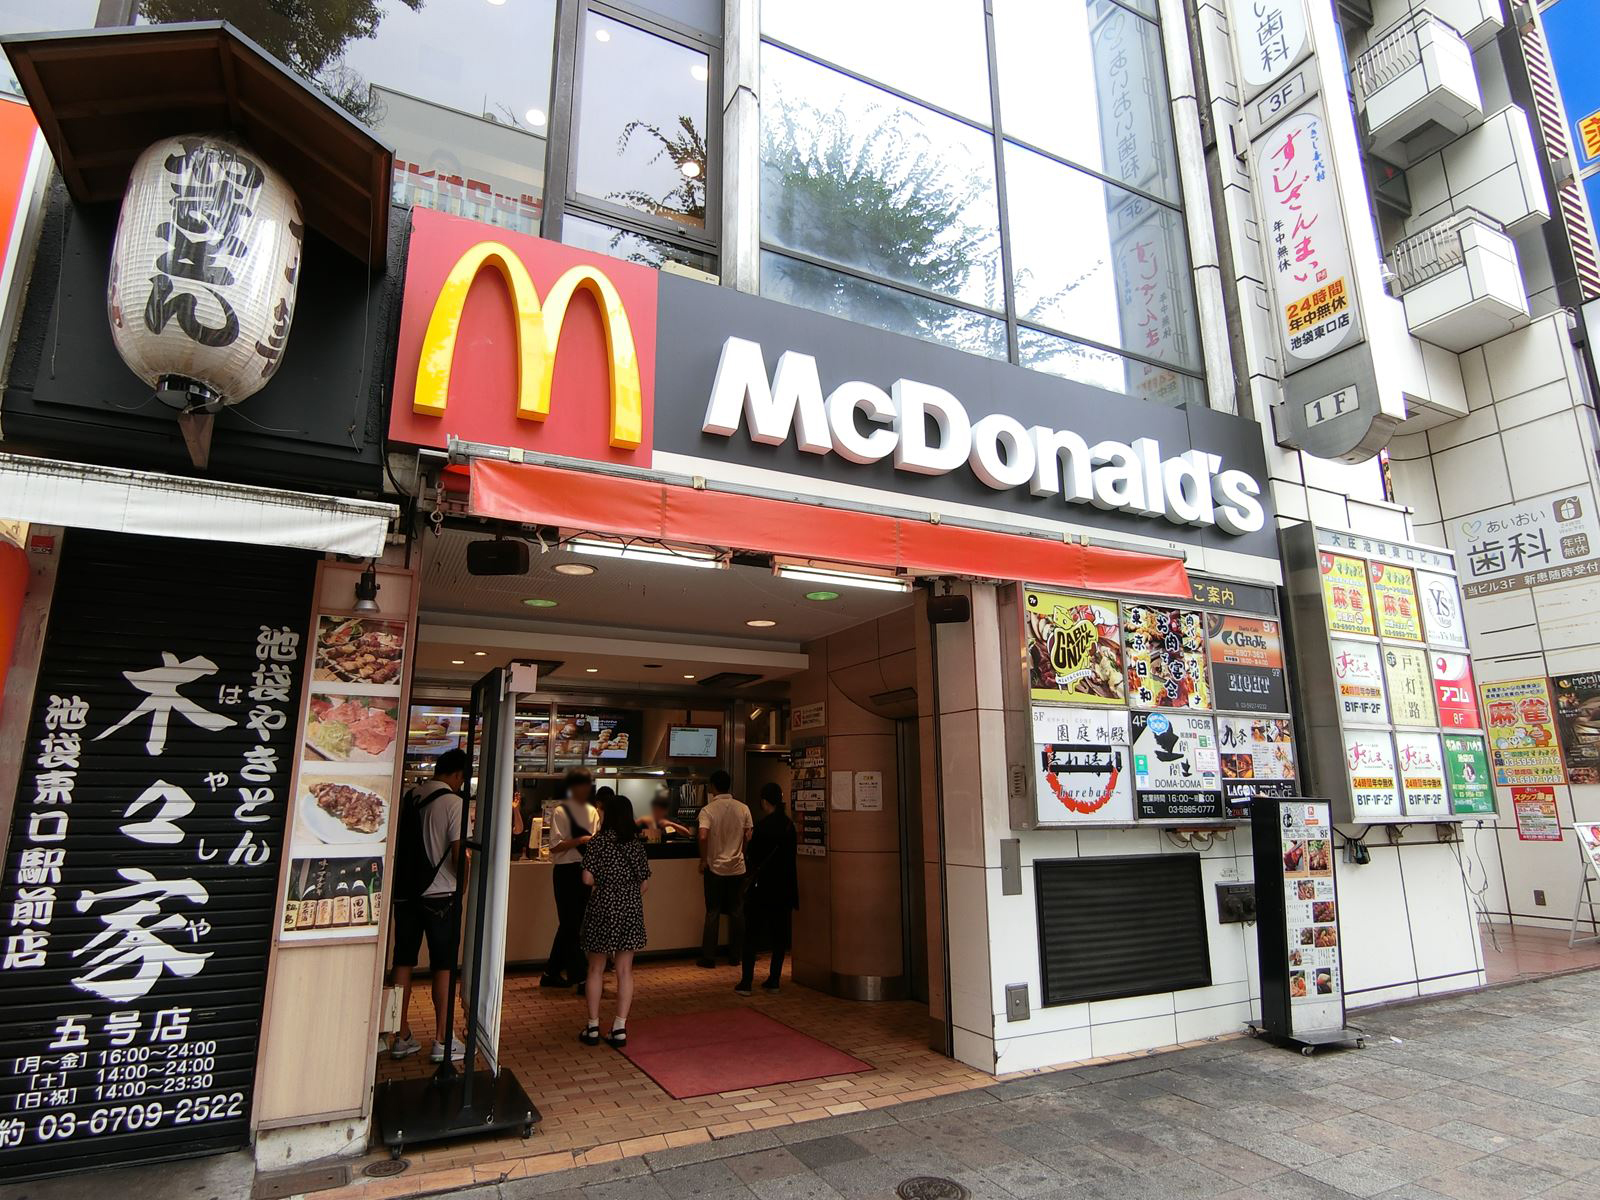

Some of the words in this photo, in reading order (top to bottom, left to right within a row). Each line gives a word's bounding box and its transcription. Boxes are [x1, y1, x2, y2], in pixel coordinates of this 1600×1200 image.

[1269, 83, 1294, 113] 3F
[1273, 219, 1292, 273] 年中無休
[1287, 279, 1345, 320] 24時間
[1289, 296, 1348, 332] 年中無休
[1291, 312, 1350, 352] 池袋東口店
[702, 334, 1267, 537] McDonald's
[1487, 510, 1545, 534] あいおい
[1467, 528, 1552, 577] 歯科
[1562, 536, 1585, 547] 年中
[1564, 545, 1589, 557] 無休
[1467, 579, 1516, 596] 当ビル3F
[1524, 562, 1599, 586] 新患随時受付
[1193, 583, 1235, 606] ご案内
[1332, 585, 1364, 612] 麻雀
[1383, 594, 1412, 618] 麻雀
[1234, 631, 1267, 650] GROVE
[1132, 608, 1152, 703] 東京日和
[1439, 686, 1469, 703] アコム
[1034, 711, 1044, 721] 5F
[1132, 715, 1146, 727] 4F
[1453, 711, 1464, 724] 8F
[1489, 698, 1548, 726] 麻雀
[228, 624, 300, 867] 池袋やきとん
[1142, 805, 1156, 814] TEL
[1168, 805, 1215, 814] 03-5985-0777
[3, 694, 90, 970] 池袋東口駅前店
[49, 1006, 192, 1050] 五号店
[38, 1092, 244, 1142] 03-6709-2522
